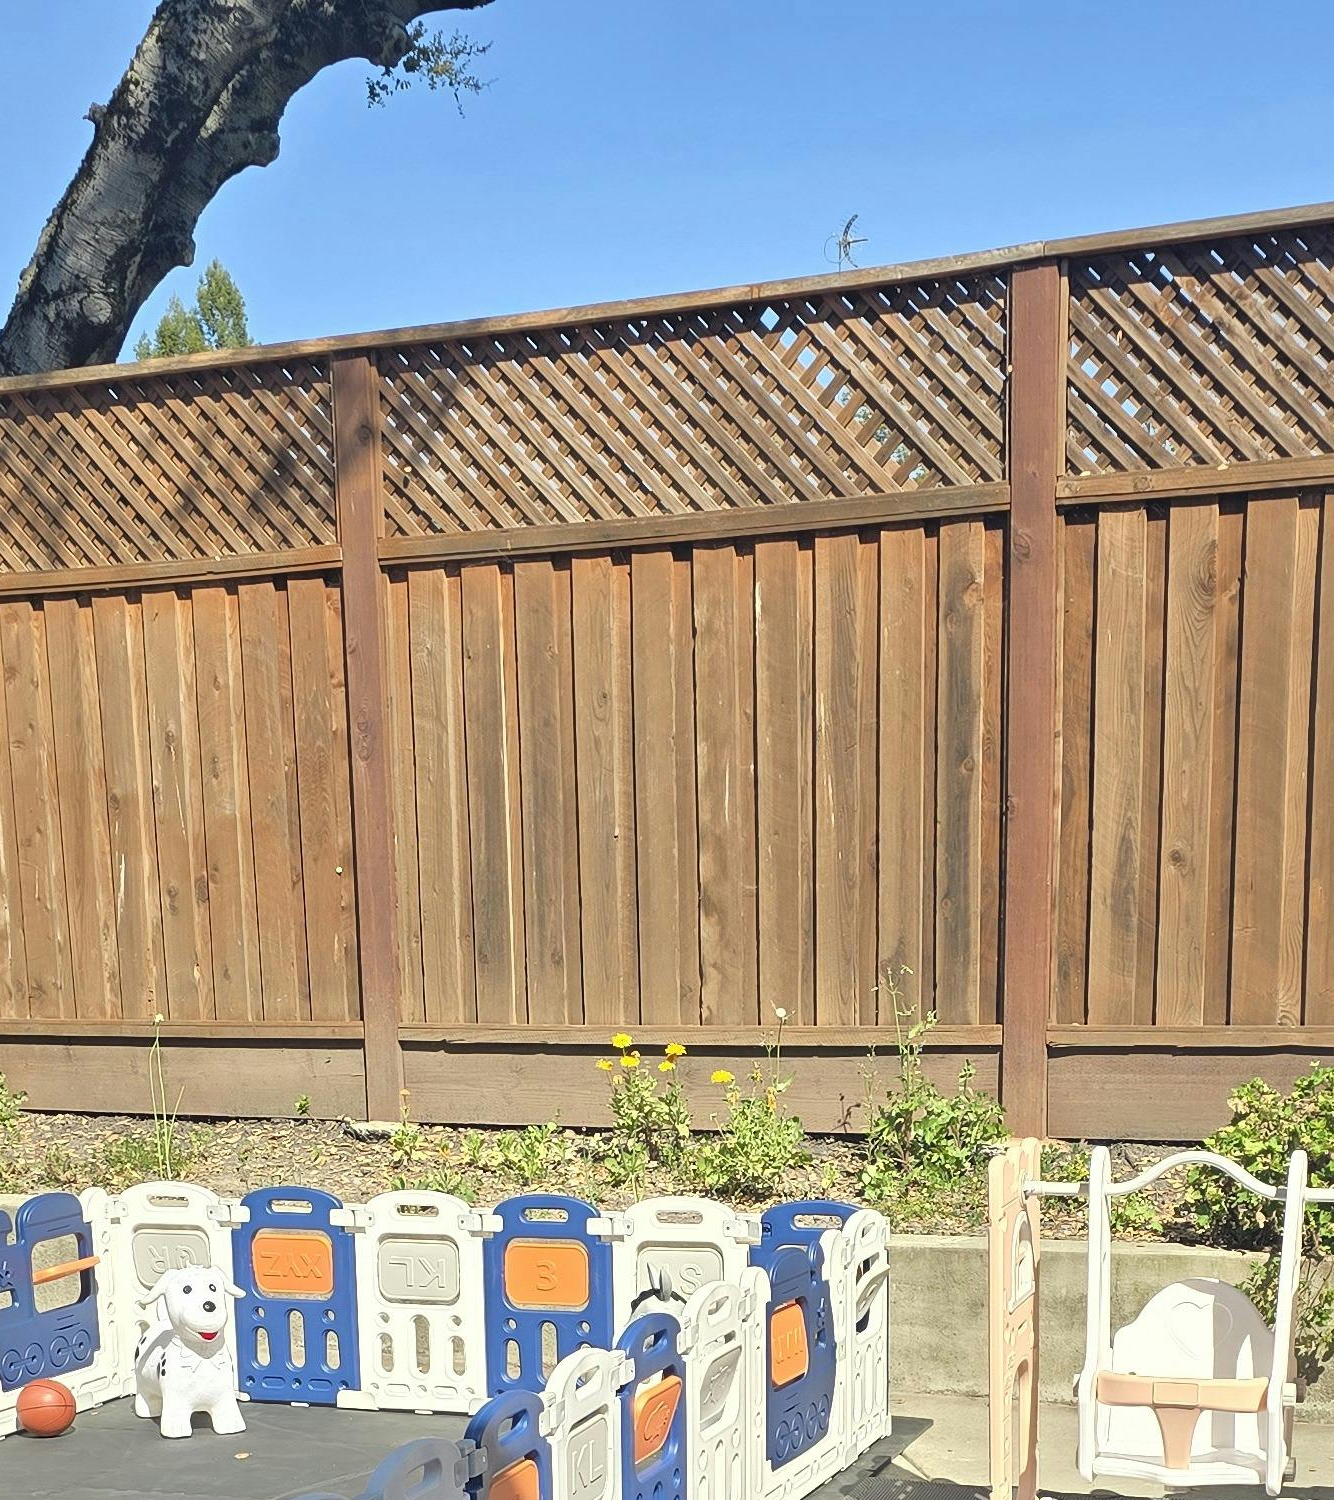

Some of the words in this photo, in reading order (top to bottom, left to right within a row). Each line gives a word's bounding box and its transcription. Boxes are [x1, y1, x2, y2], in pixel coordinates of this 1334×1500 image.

[261, 1251, 324, 1279] XYZ
[388, 1255, 446, 1289] KL
[535, 1259, 558, 1292] 3
[571, 1440, 604, 1495] KL
